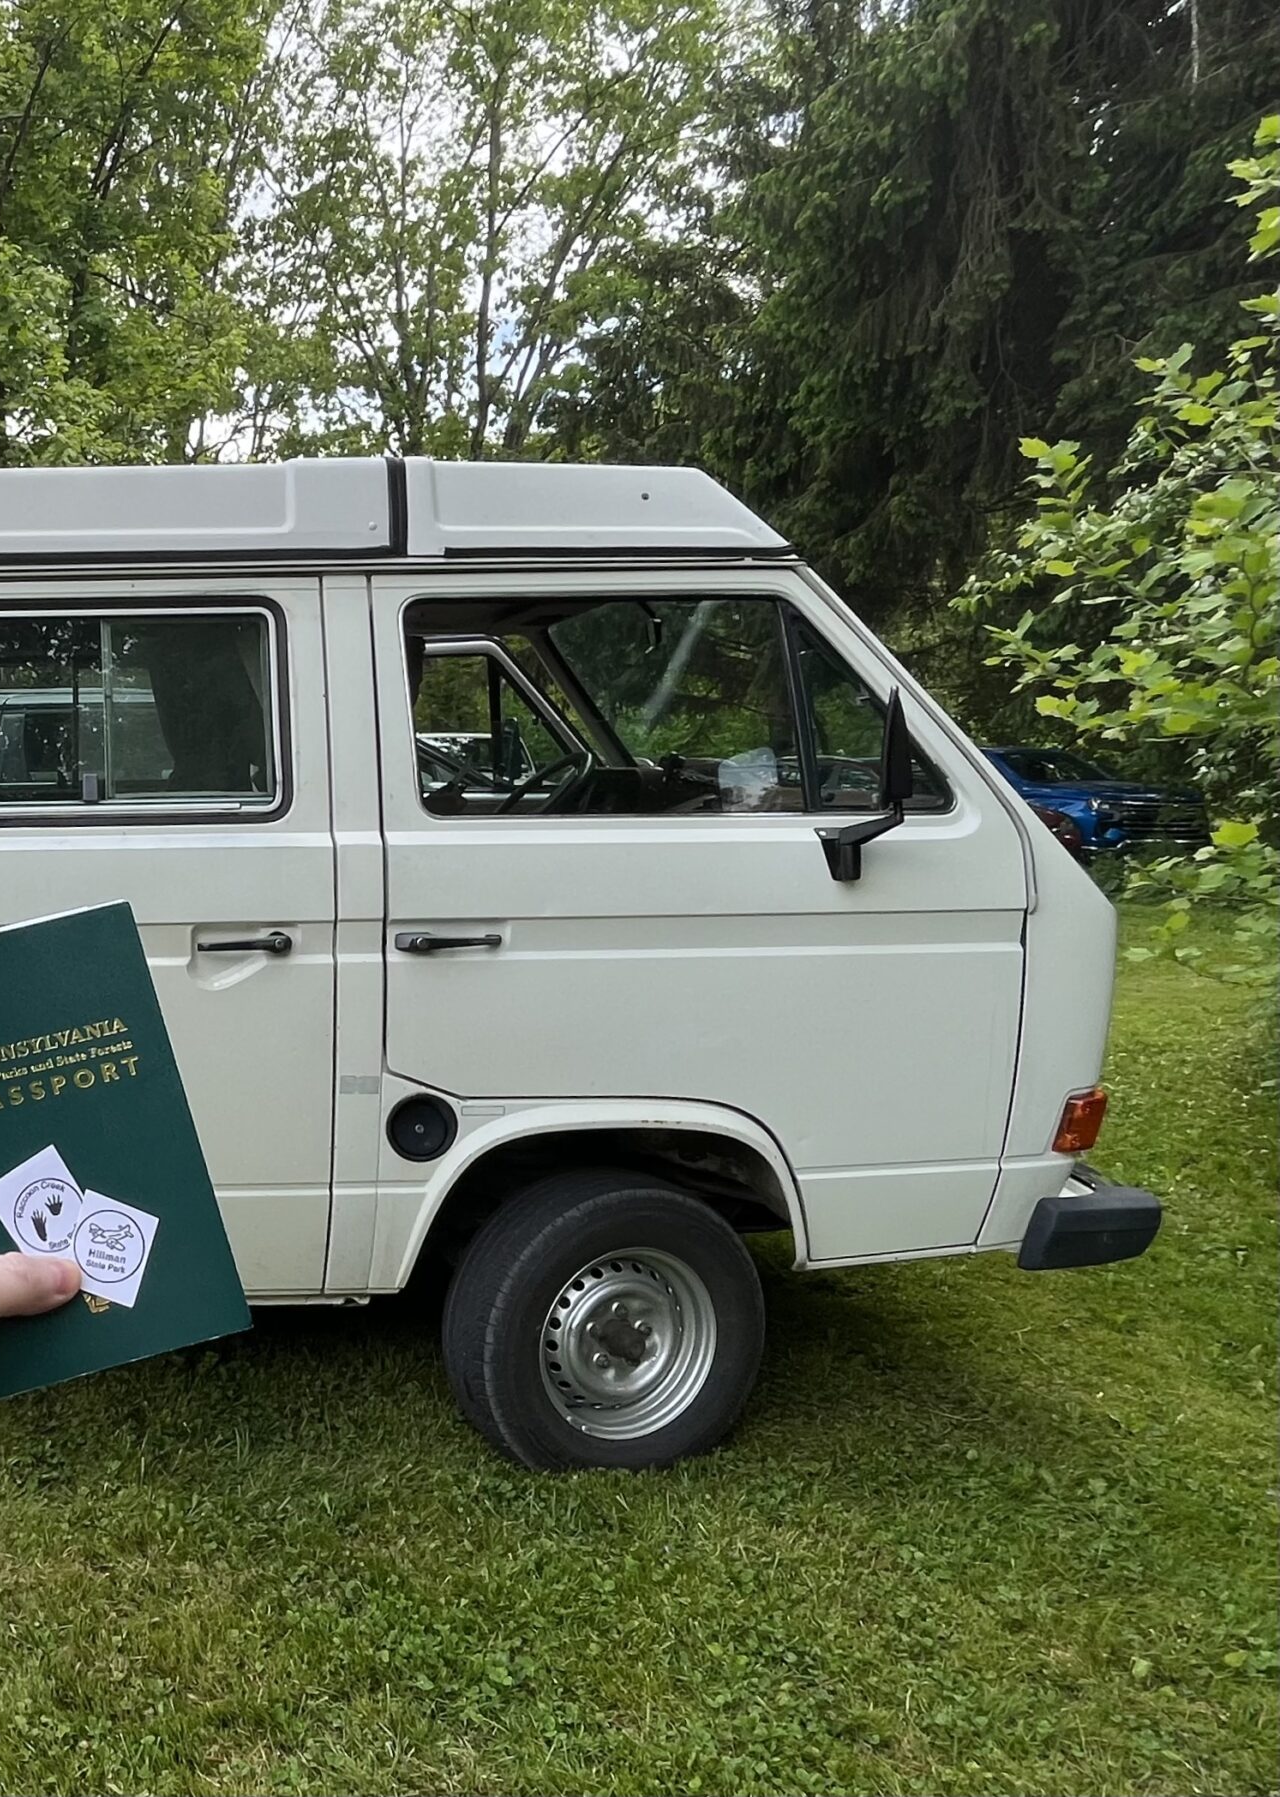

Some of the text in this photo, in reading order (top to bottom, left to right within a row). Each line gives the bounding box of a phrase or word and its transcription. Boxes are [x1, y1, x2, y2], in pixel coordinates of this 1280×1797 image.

[30, 1058, 55, 1073] and
[56, 1052, 87, 1067] State
[89, 1040, 133, 1059] Forests
[40, 1181, 65, 1192] Creek
[88, 1249, 126, 1264] Hillman
[85, 1259, 126, 1274] State Park
